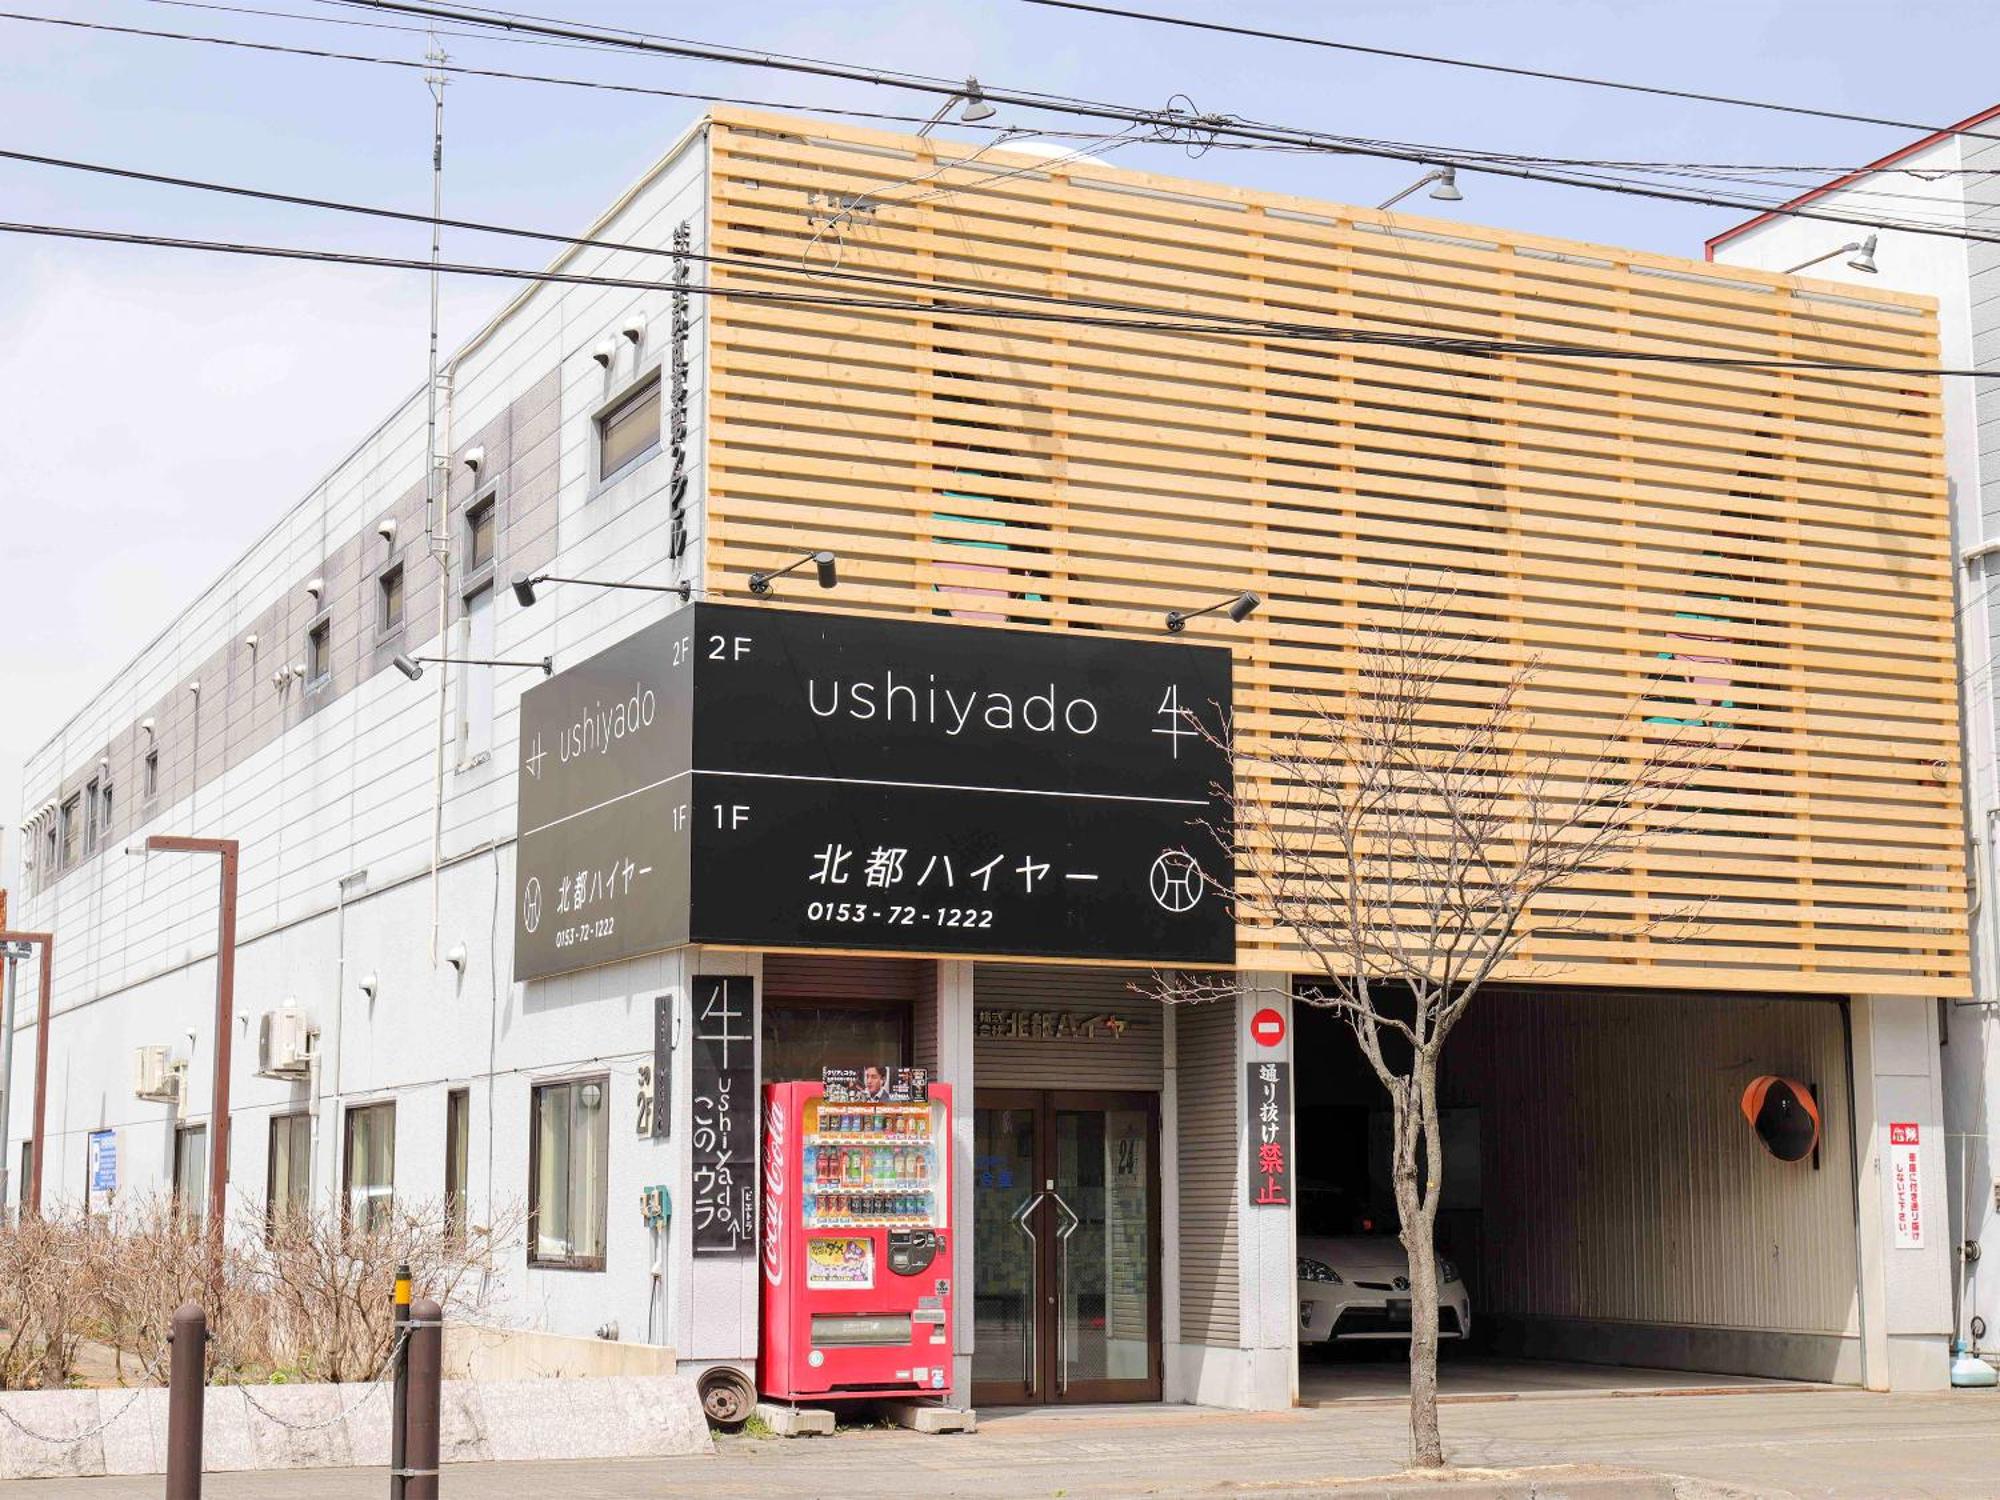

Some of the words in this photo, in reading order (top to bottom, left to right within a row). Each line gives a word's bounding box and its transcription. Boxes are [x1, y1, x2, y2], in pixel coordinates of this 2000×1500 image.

[672, 637, 690, 667] 2F
[708, 635, 753, 662] 2F
[559, 682, 656, 763] ushiyado
[807, 670, 1098, 738] ushiyado
[672, 805, 688, 832] 1F
[712, 804, 752, 831] 1F
[556, 855, 653, 913] 北都ハイヤー
[807, 842, 1100, 897] 北都ハイヤー
[555, 917, 615, 948] 0153-72-1222
[716, 1077, 732, 1222] ushiyado
[1255, 1064, 1288, 1205] 通り抜け禁止
